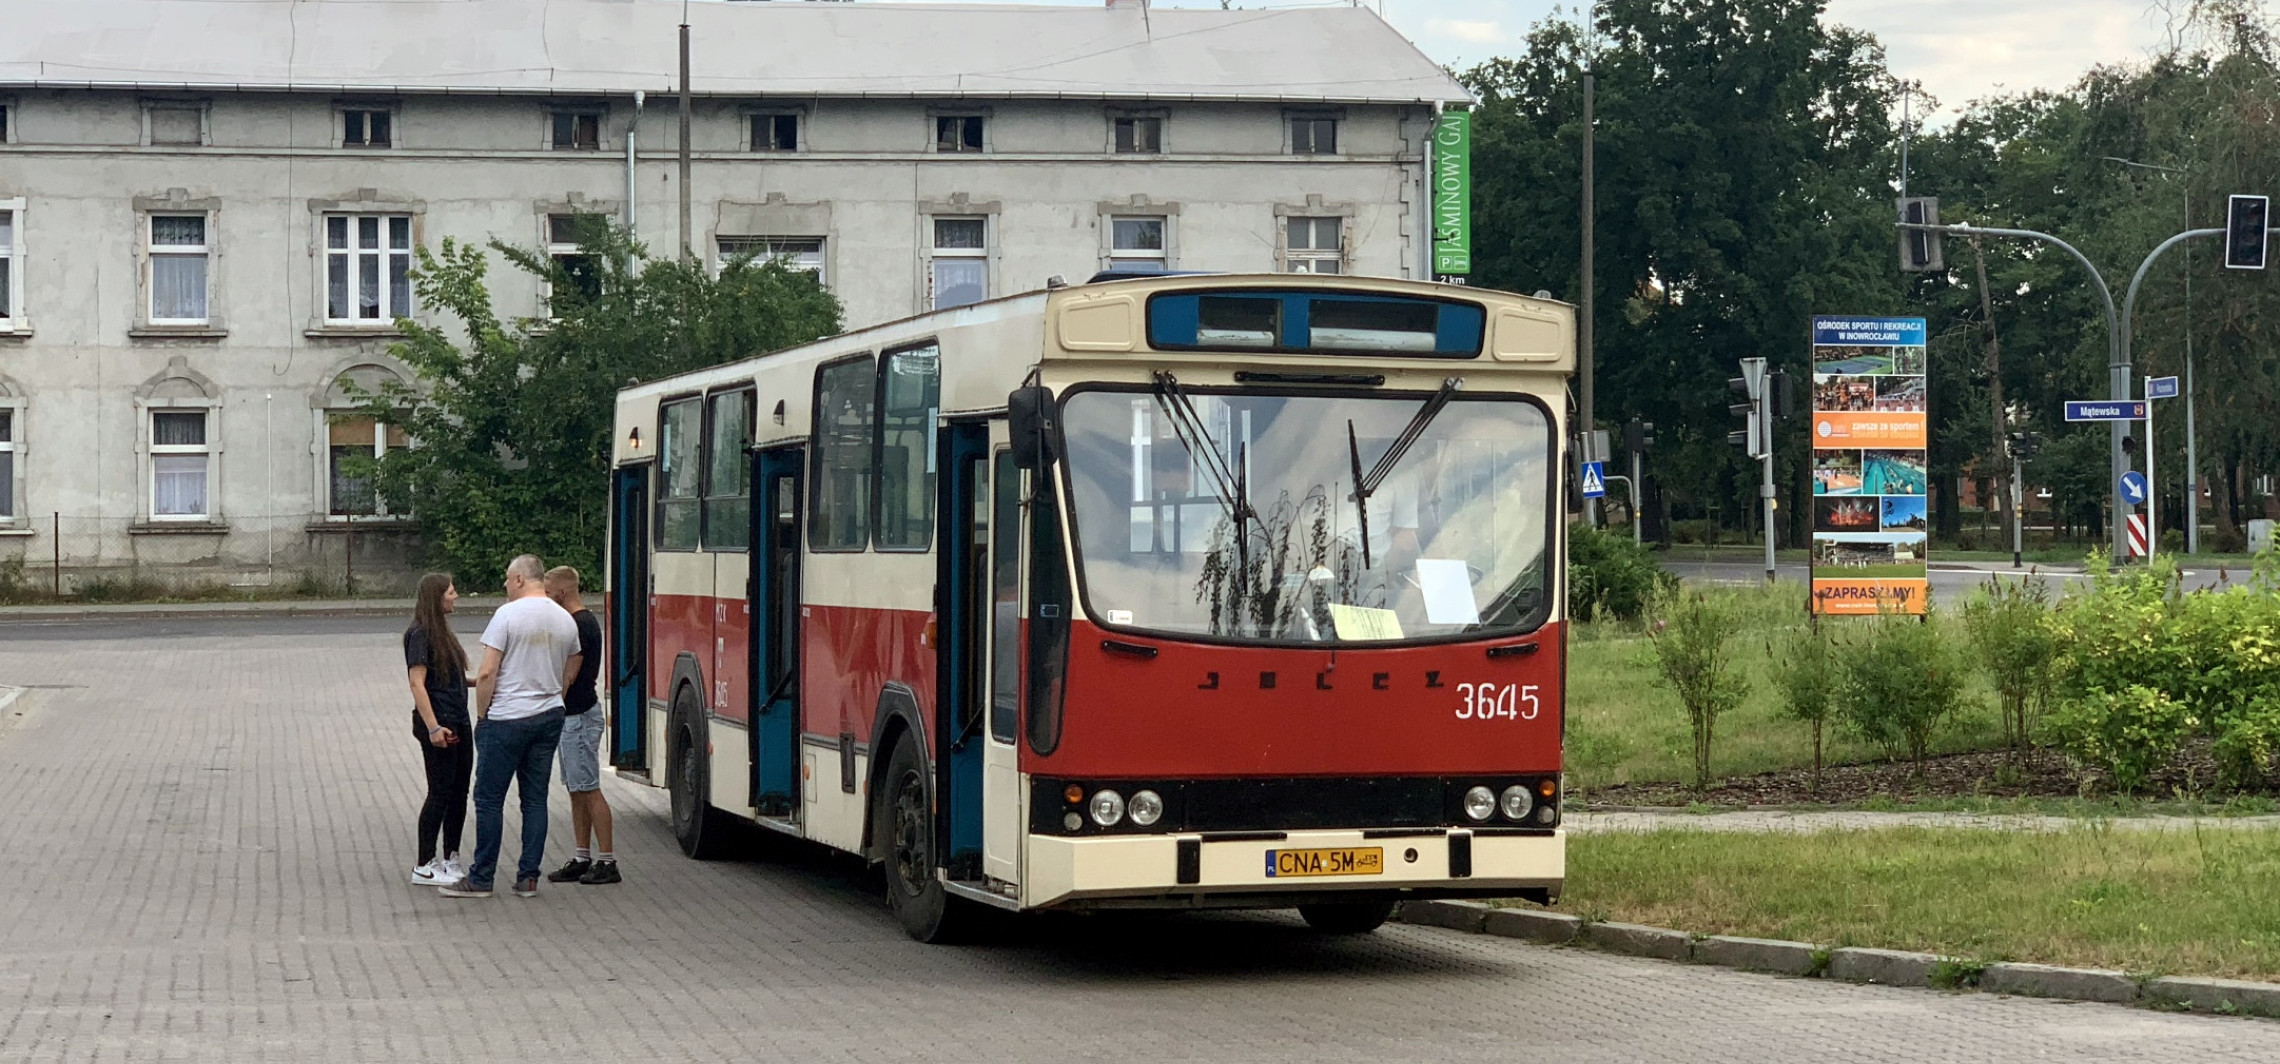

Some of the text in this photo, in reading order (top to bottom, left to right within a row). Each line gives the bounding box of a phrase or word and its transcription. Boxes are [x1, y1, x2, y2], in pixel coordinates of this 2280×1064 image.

[1437, 115, 1467, 253] JAŚMINOWY GAJ
[1441, 257, 1450, 268] P
[1440, 275, 1465, 285] 2 km
[1817, 320, 1850, 330] OŚRODEK
[1851, 321, 1879, 330] SPORTU
[1883, 322, 1922, 331] REKREACJI
[1838, 332, 1900, 341] W INOWROCŁAWIU
[2080, 406, 2120, 418] Mątewska
[1852, 422, 1878, 431] zawsze
[1880, 423, 1889, 431] ze
[1889, 421, 1919, 432] sportem
[1455, 682, 1539, 720] 3645
[1280, 851, 1354, 873] CNA 5M
